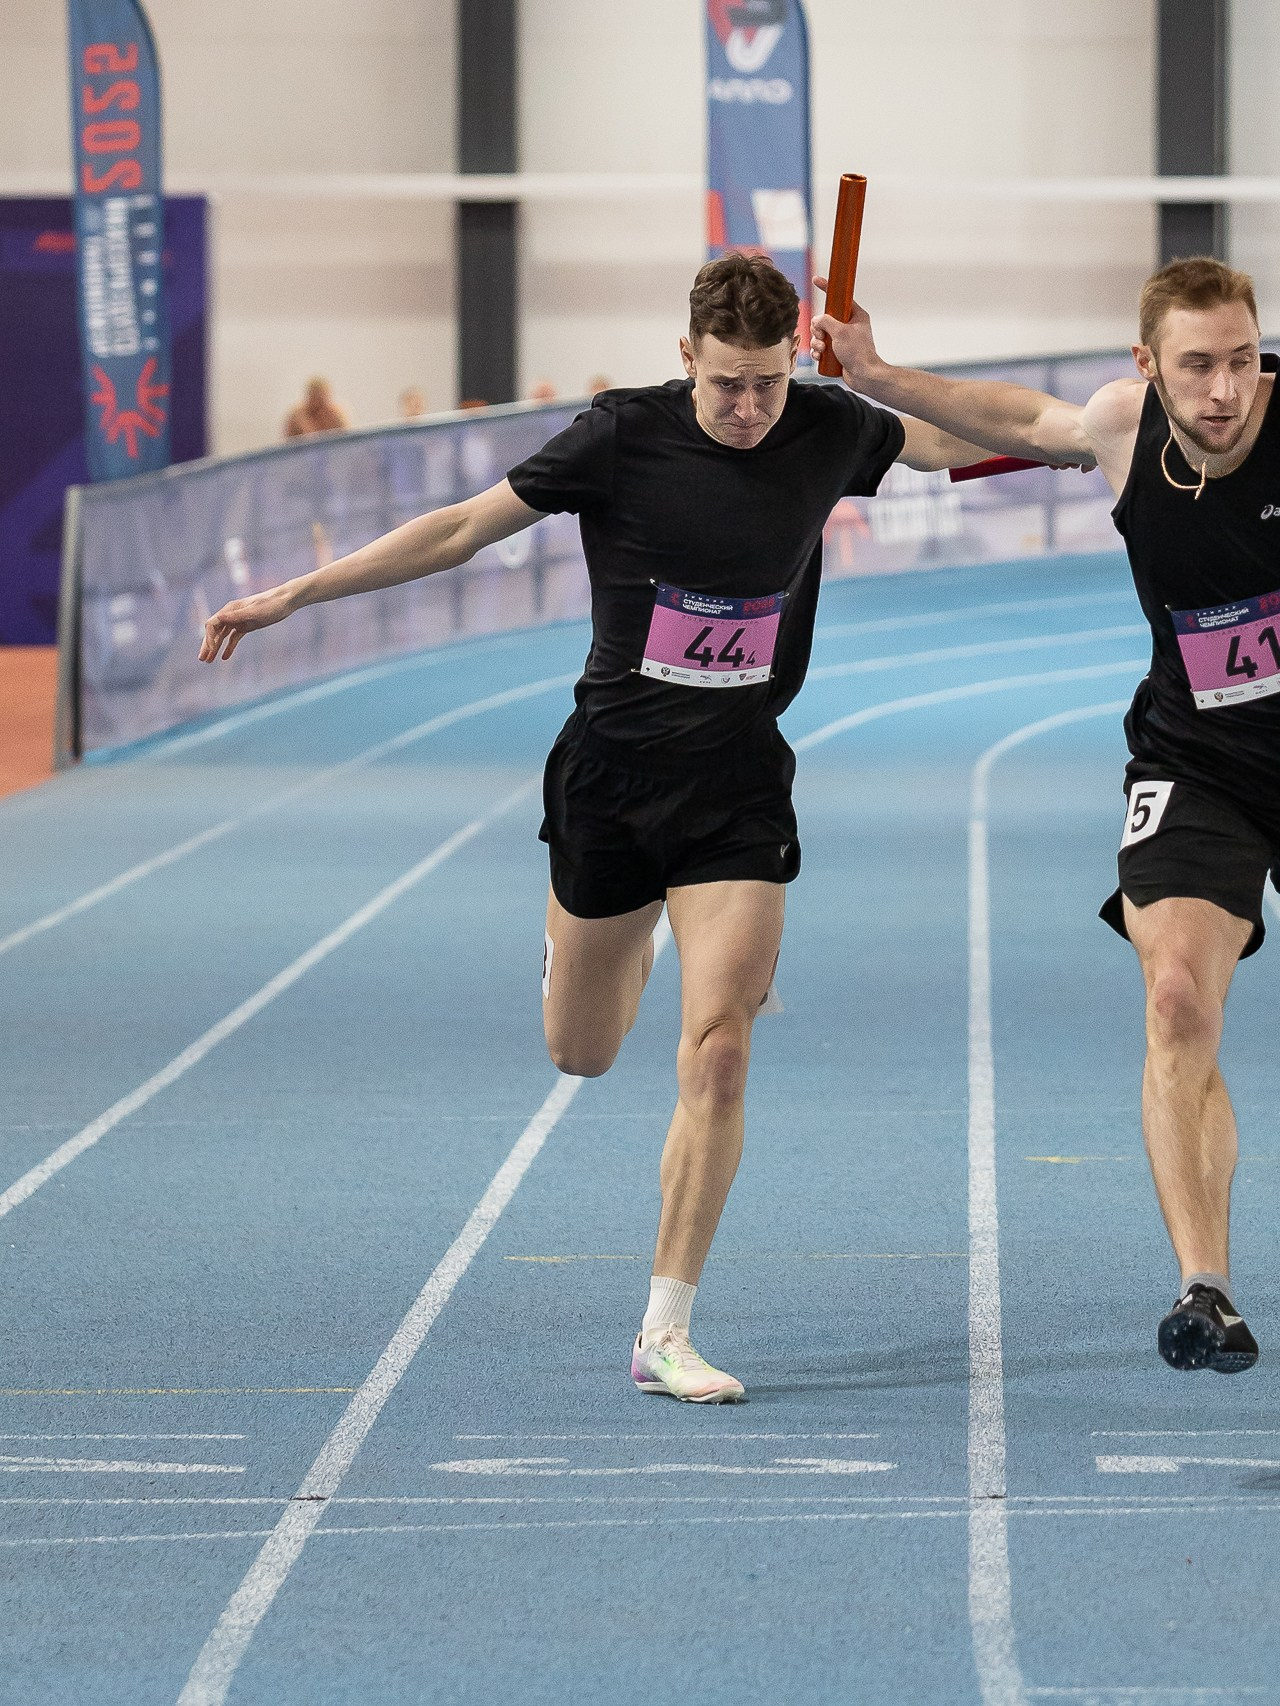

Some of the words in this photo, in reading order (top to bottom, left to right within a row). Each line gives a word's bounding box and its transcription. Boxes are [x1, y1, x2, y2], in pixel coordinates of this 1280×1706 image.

[682, 603, 722, 615] ЧЕМПИОНАТ
[683, 598, 734, 611] СТУДЕНЧЕСКИЙ
[683, 626, 746, 669] 44
[746, 650, 756, 666] 4
[1130, 791, 1158, 833] 5
